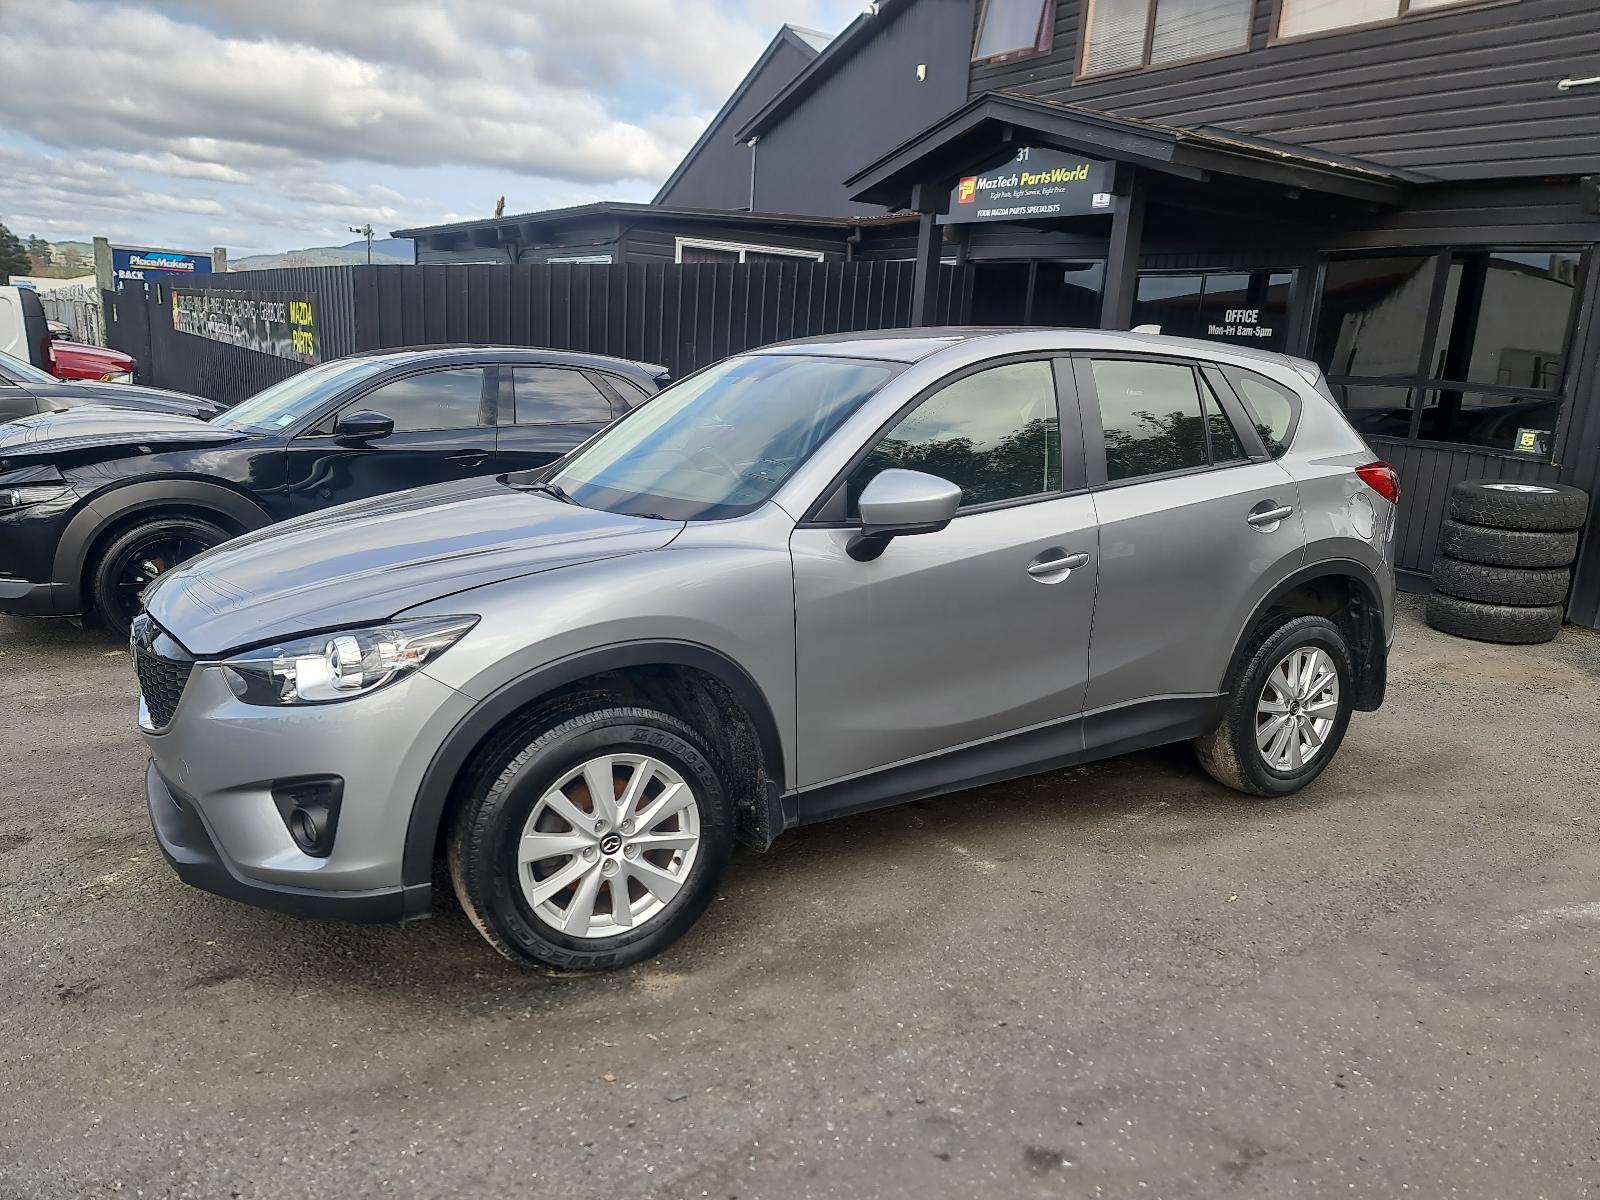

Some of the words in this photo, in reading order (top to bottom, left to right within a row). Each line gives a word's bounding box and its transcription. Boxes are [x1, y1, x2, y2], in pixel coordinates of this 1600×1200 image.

[1016, 146, 1030, 162] 31
[976, 173, 1018, 190] MazTech
[1020, 164, 1090, 187] PartsWorld
[990, 192, 1001, 201] Right
[1013, 190, 1025, 199] Right
[1042, 187, 1054, 196] Right
[1054, 186, 1067, 194] Price
[976, 209, 991, 218] YOUR
[991, 208, 1009, 217] MAZDA
[1009, 206, 1026, 216] PARTS
[1026, 204, 1061, 214] SPECIALISTS
[129, 255, 195, 269] PlaceMakers
[118, 270, 145, 280] BACK
[289, 300, 314, 326] MAZDA
[1225, 309, 1259, 323] OFFICE
[1208, 325, 1236, 336] Mon-Fri
[1236, 326, 1273, 337] 8am-5pm
[292, 329, 314, 356] PARTS
